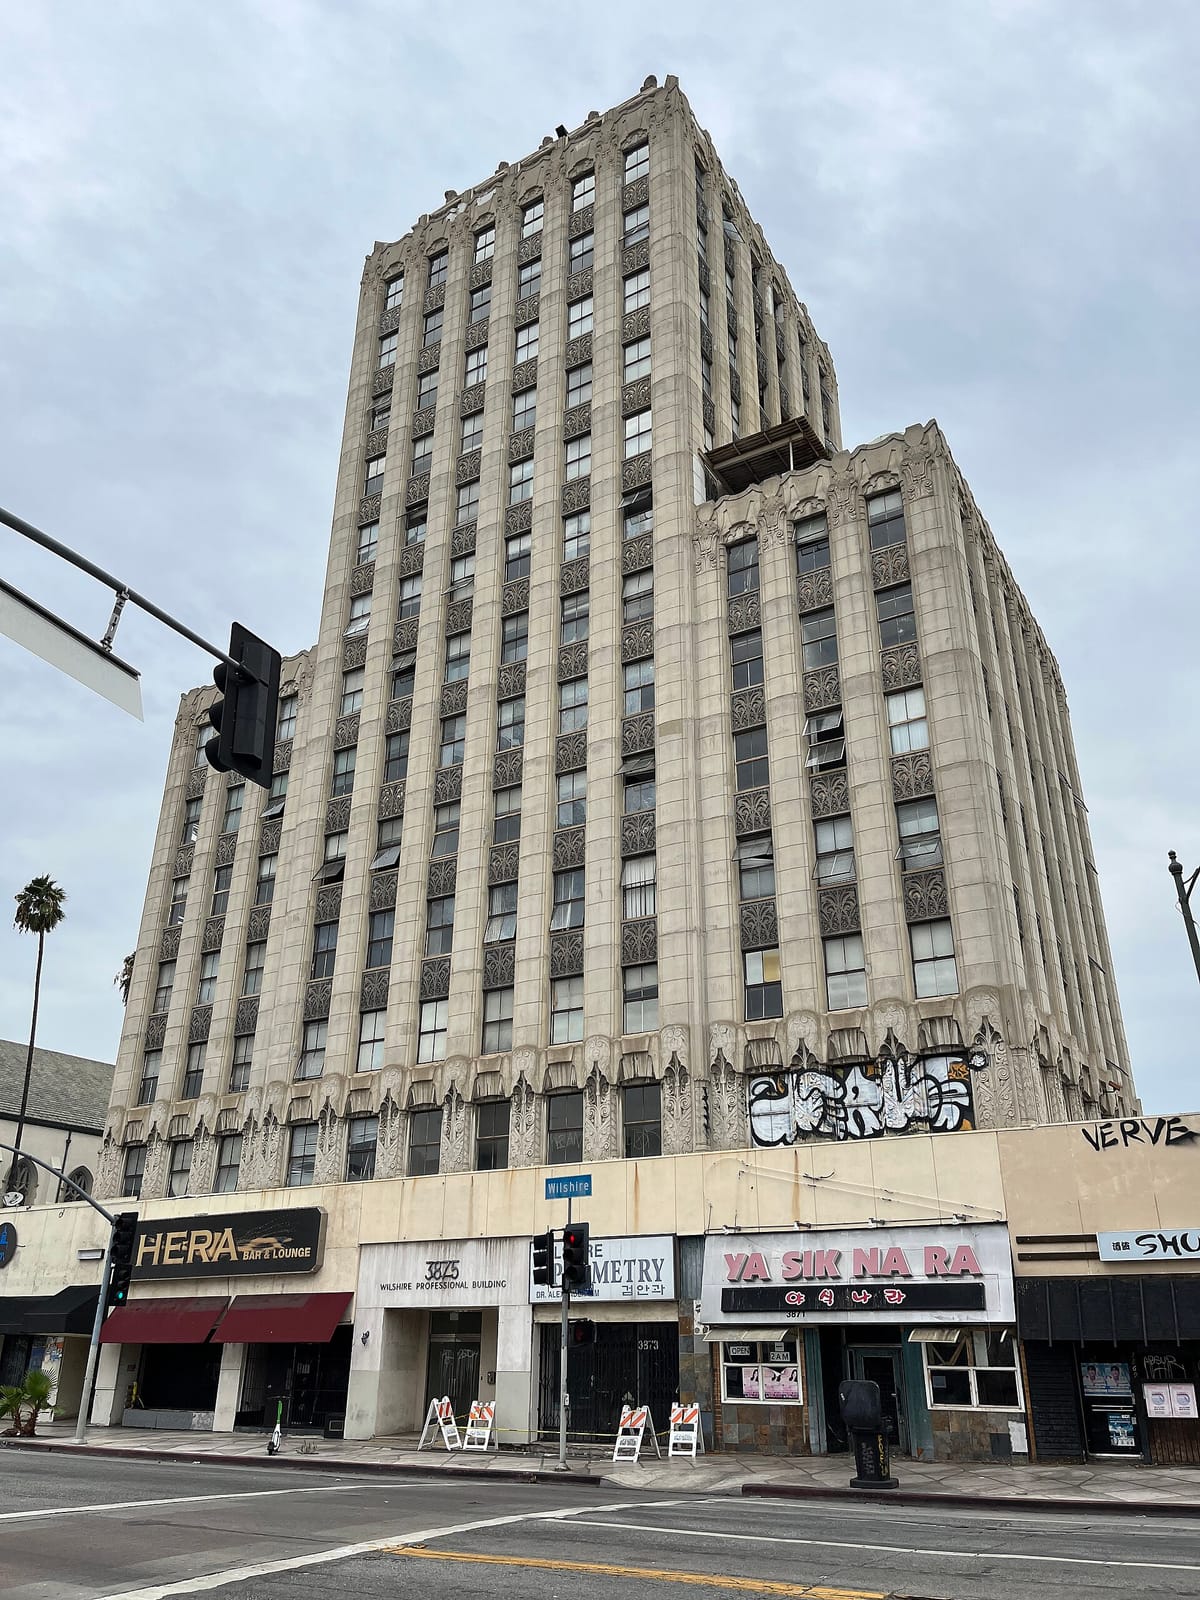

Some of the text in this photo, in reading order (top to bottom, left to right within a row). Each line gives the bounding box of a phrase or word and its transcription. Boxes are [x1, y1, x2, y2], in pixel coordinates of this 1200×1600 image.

[547, 1181, 590, 1194] Wilshire
[135, 1227, 239, 1267] HERA
[242, 1247, 312, 1261] BAR & LOUNGE
[424, 1260, 460, 1280] 3875
[724, 1245, 984, 1282] YA SIK NA RA
[553, 1258, 665, 1285] PMETRY
[380, 1279, 507, 1291] WILSHIRE PROFESSIONAL BUILDING
[536, 1291, 547, 1299] DR.
[731, 1347, 750, 1355] OPEN
